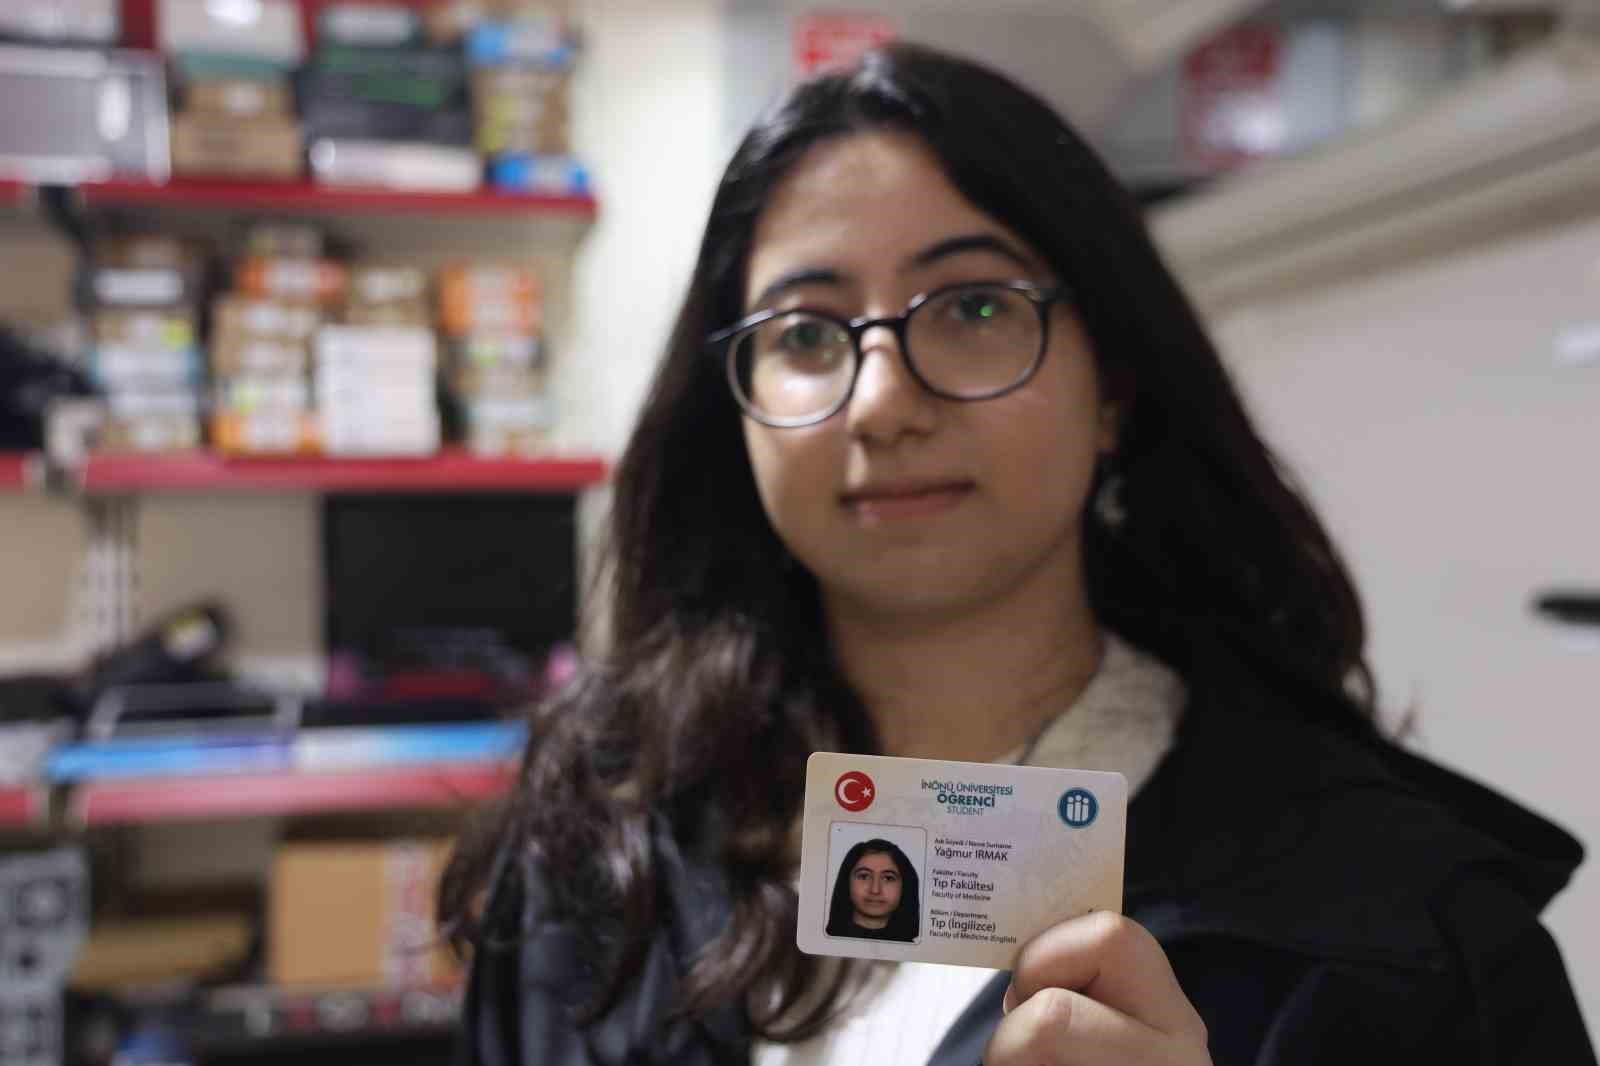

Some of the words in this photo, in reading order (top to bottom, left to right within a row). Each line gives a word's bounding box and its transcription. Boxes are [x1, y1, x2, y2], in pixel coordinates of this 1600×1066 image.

[946, 805, 985, 816] STUDENT
[934, 846, 972, 859] Yağmur
[975, 849, 1008, 861] IRMAK
[933, 877, 948, 890] Tıp
[950, 879, 994, 891] Fakültesi
[931, 889, 954, 899] Faculty
[963, 893, 991, 901] Medicine
[953, 911, 987, 919] Department
[930, 917, 946, 929] Tıp
[929, 930, 952, 939] Faculty
[960, 932, 989, 941] Medicine
